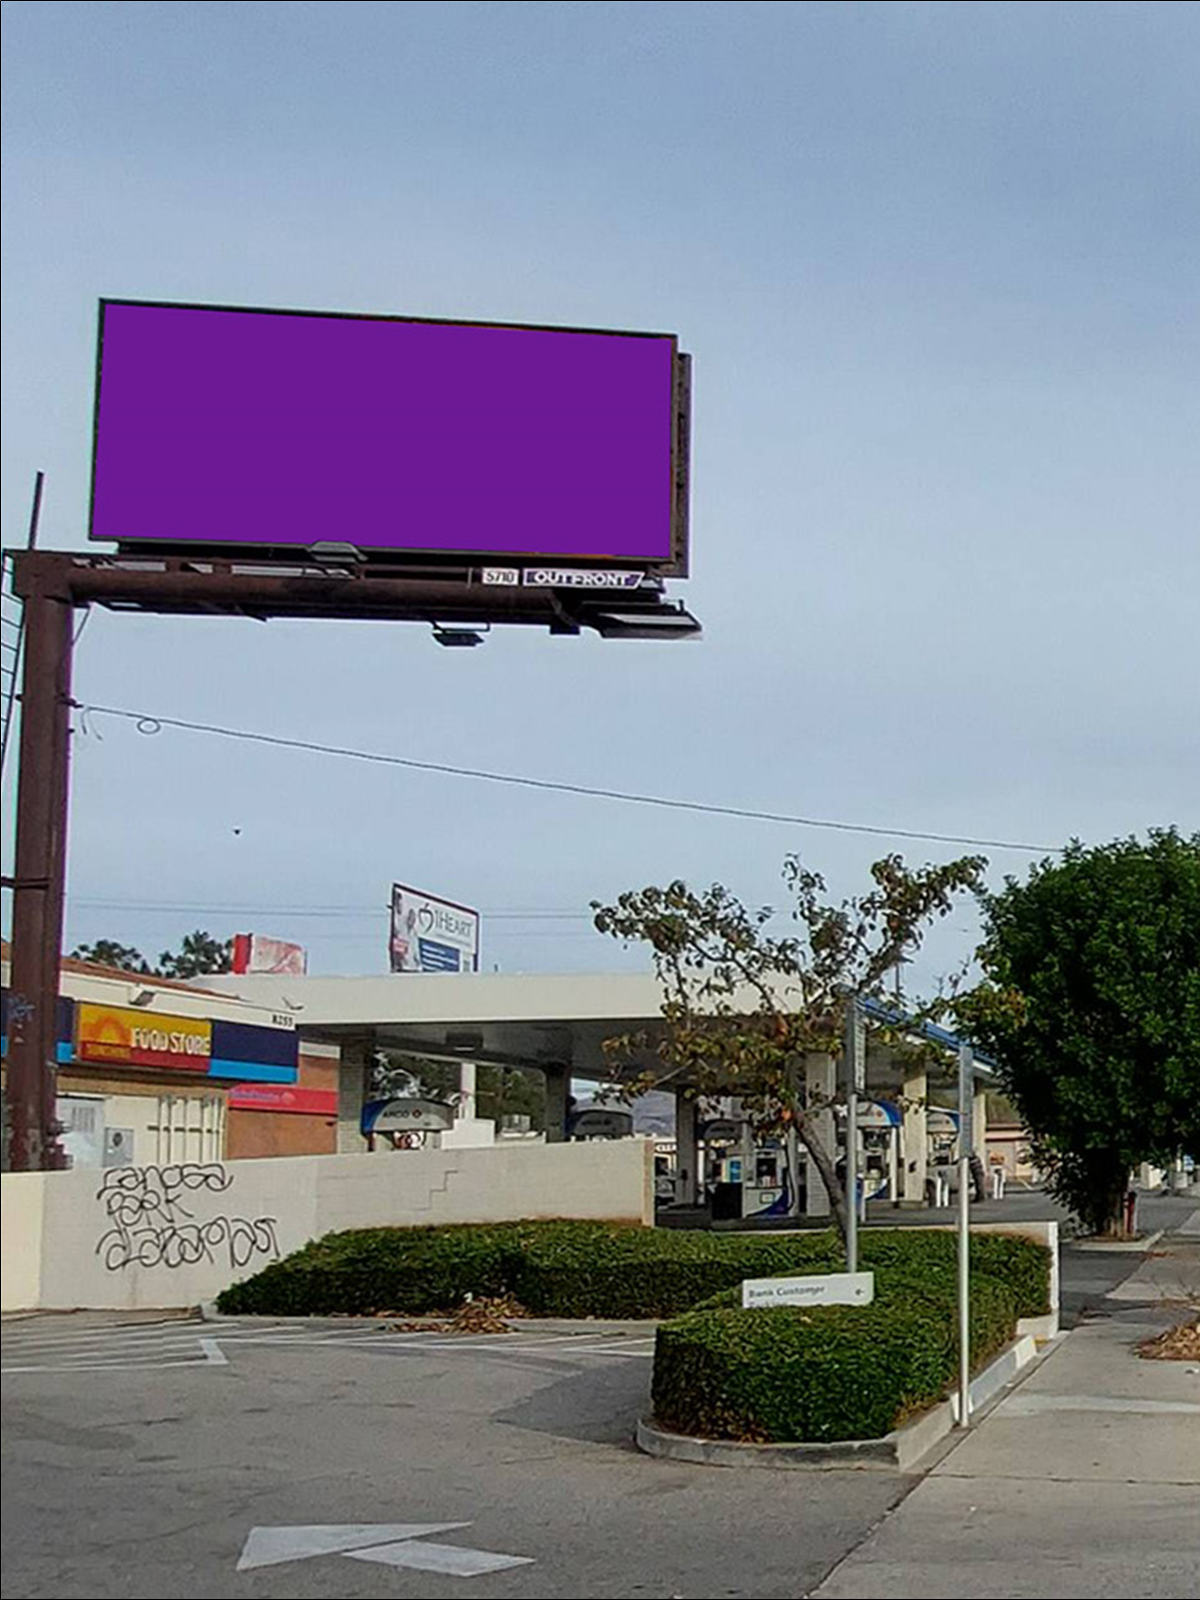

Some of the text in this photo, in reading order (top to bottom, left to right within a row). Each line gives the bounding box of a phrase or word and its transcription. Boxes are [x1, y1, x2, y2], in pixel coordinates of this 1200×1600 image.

[534, 571, 626, 586] OUTFRONT
[131, 1027, 168, 1051] FOOD
[170, 1031, 211, 1057] STORE
[748, 1286, 826, 1298] Bank Customer
